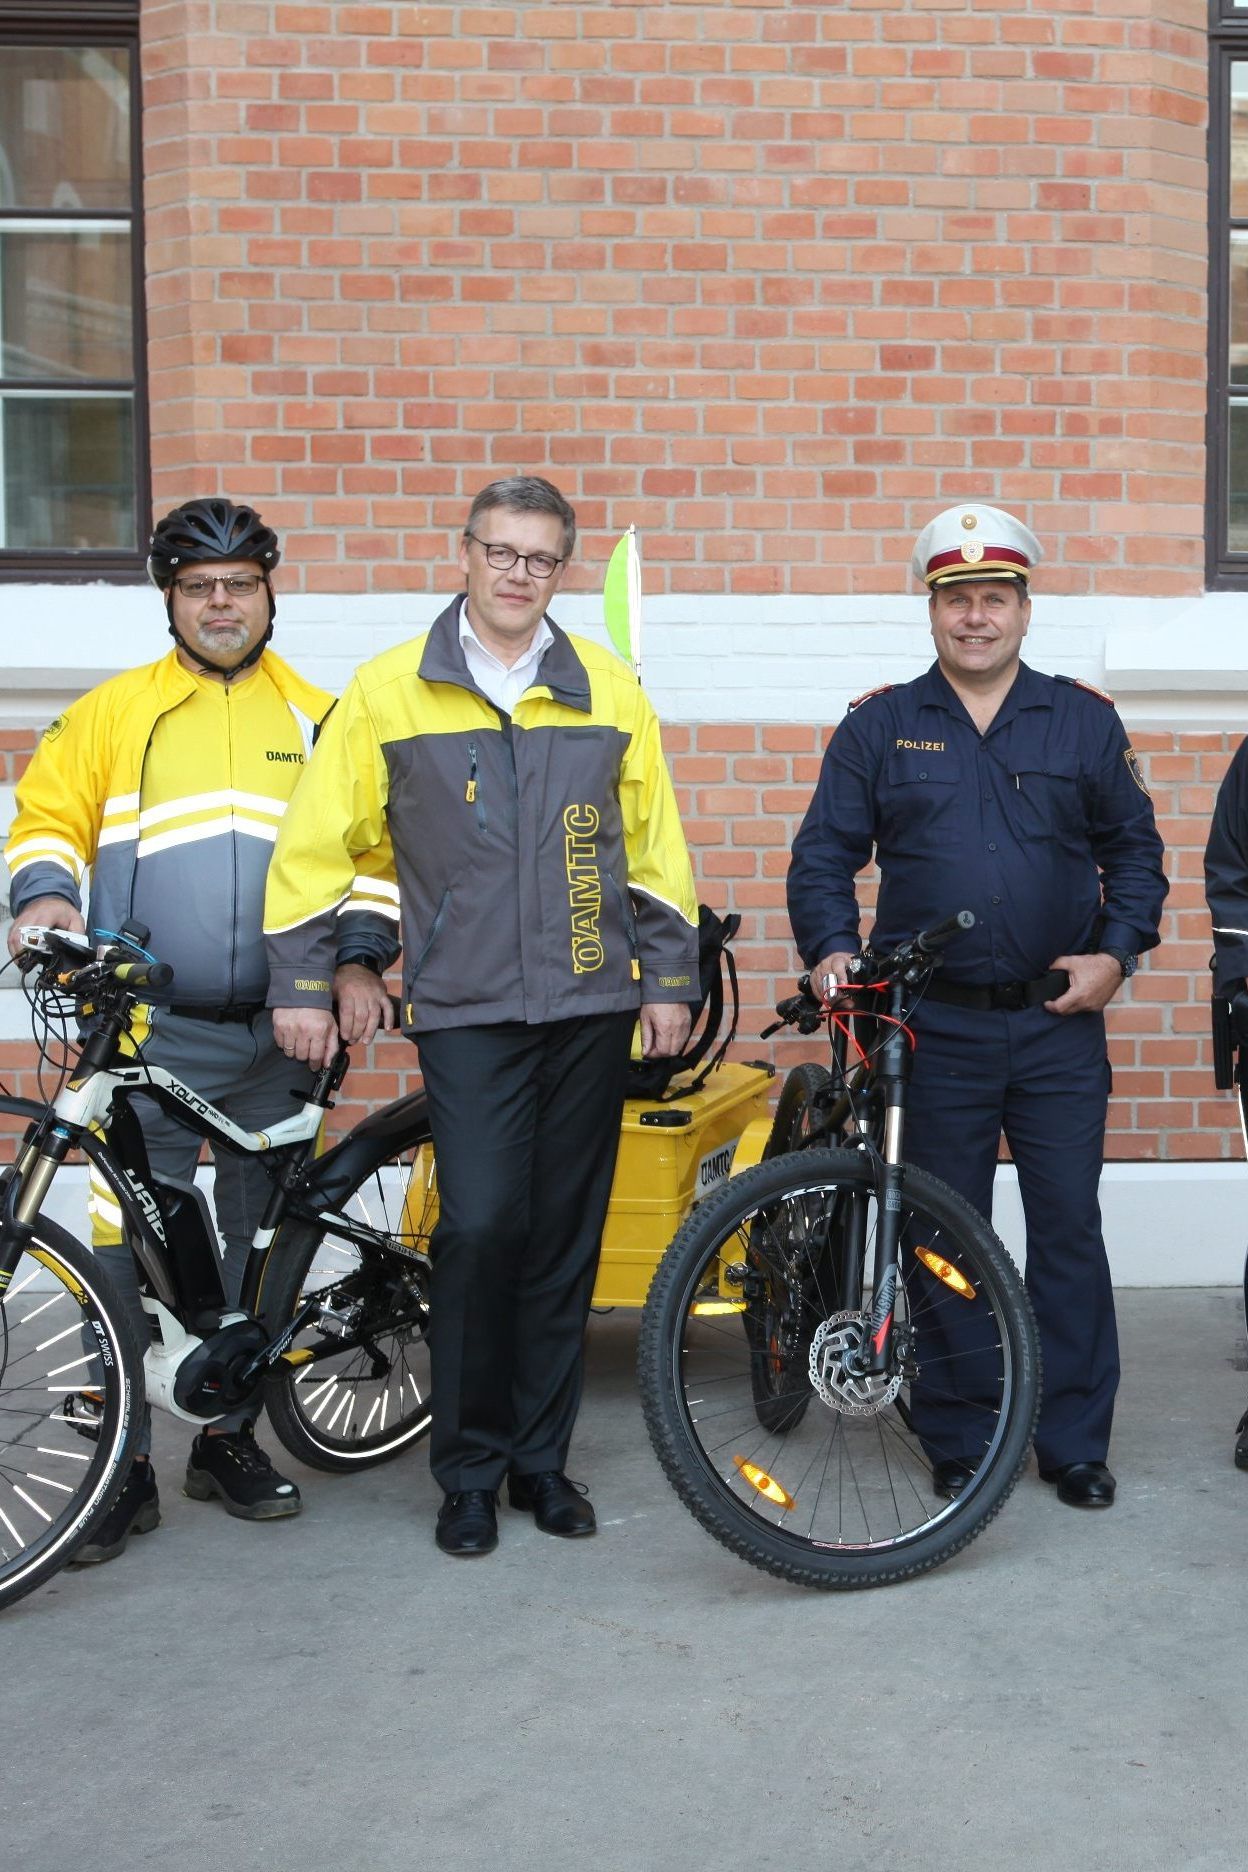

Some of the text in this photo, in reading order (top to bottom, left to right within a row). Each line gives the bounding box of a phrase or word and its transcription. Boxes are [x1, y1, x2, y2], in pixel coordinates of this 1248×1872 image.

[896, 739, 944, 751] POLIZEI
[563, 804, 604, 974] ÖAMTC
[91, 1320, 114, 1367] DT SWISS
